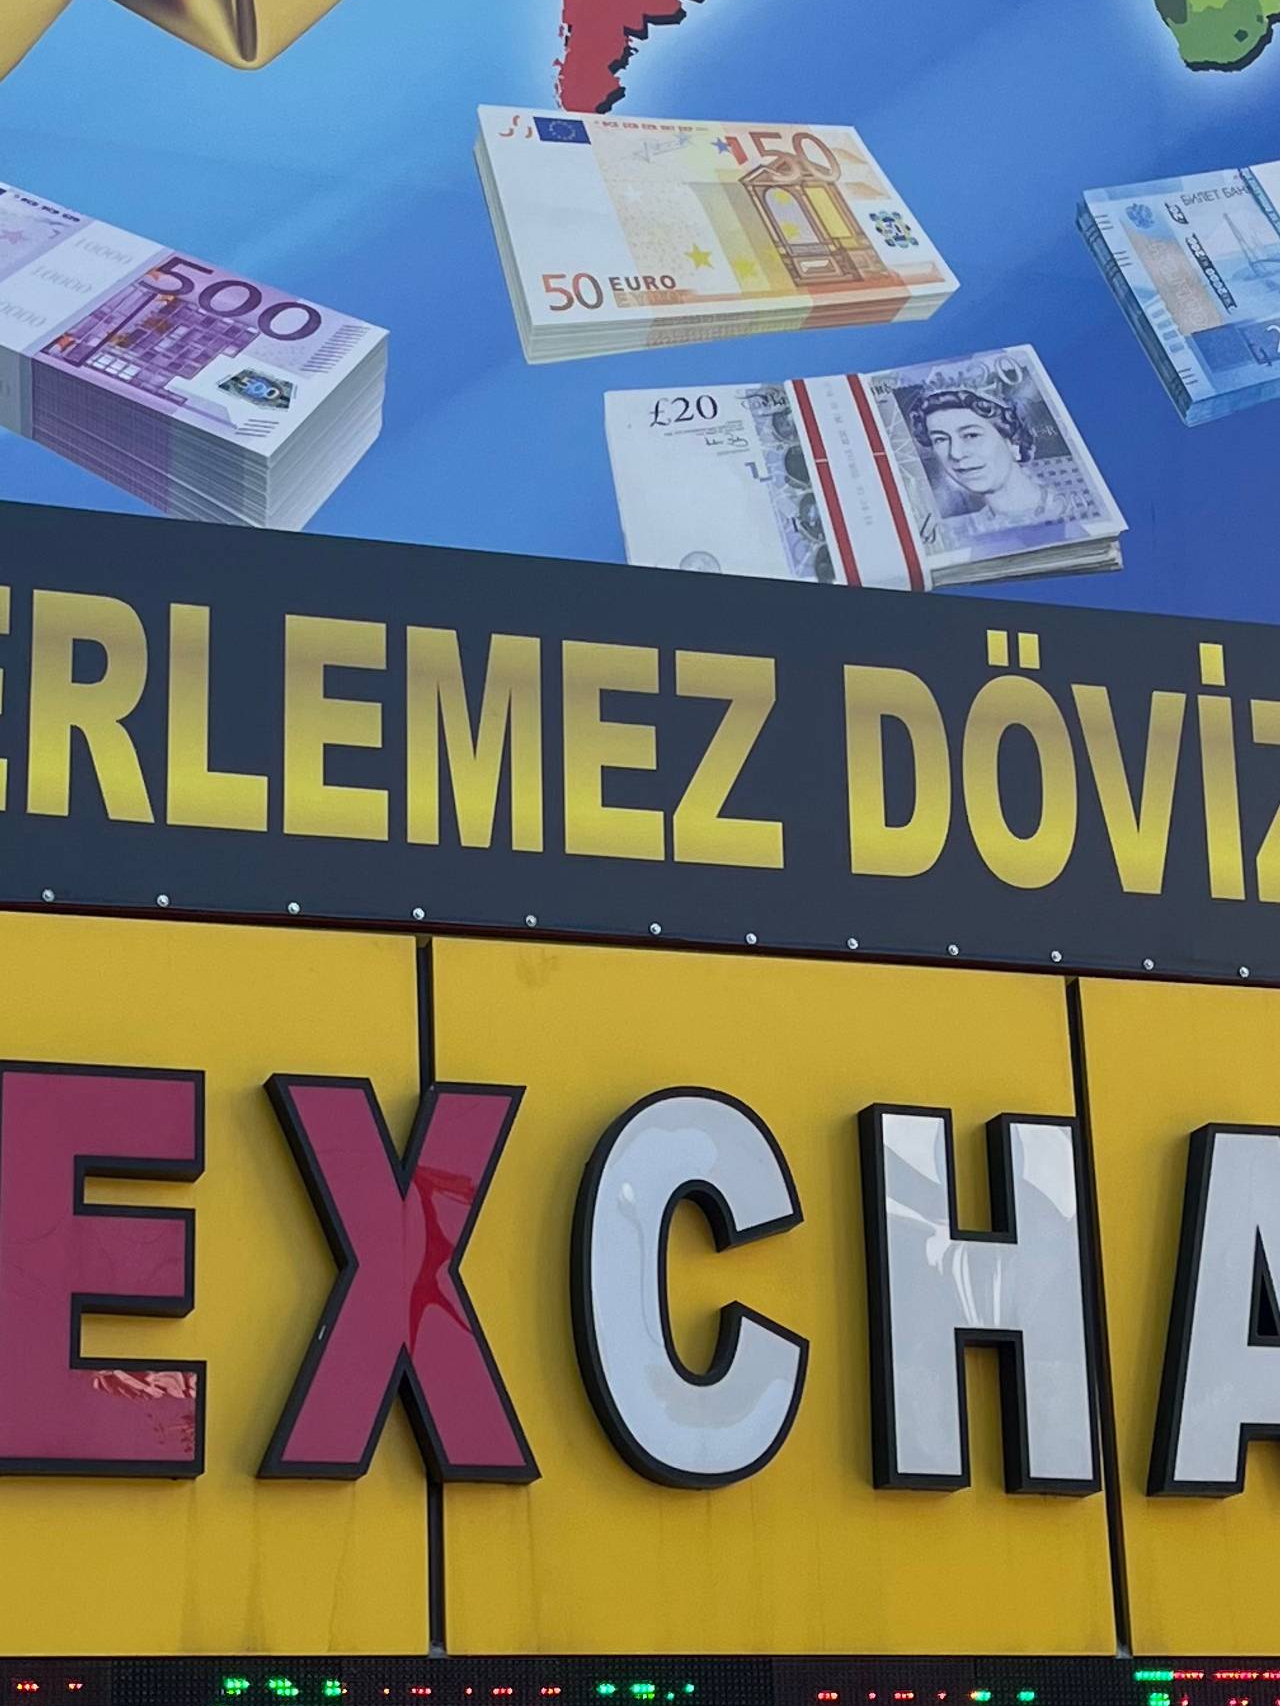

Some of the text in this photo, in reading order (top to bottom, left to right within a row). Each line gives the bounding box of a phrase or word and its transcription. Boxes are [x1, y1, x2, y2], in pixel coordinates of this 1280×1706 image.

[1180, 187, 1221, 207] БИЛЕТ
[138, 256, 321, 342] 500
[542, 272, 603, 313] 50
[609, 274, 677, 292] EURO
[649, 394, 718, 427] £20
